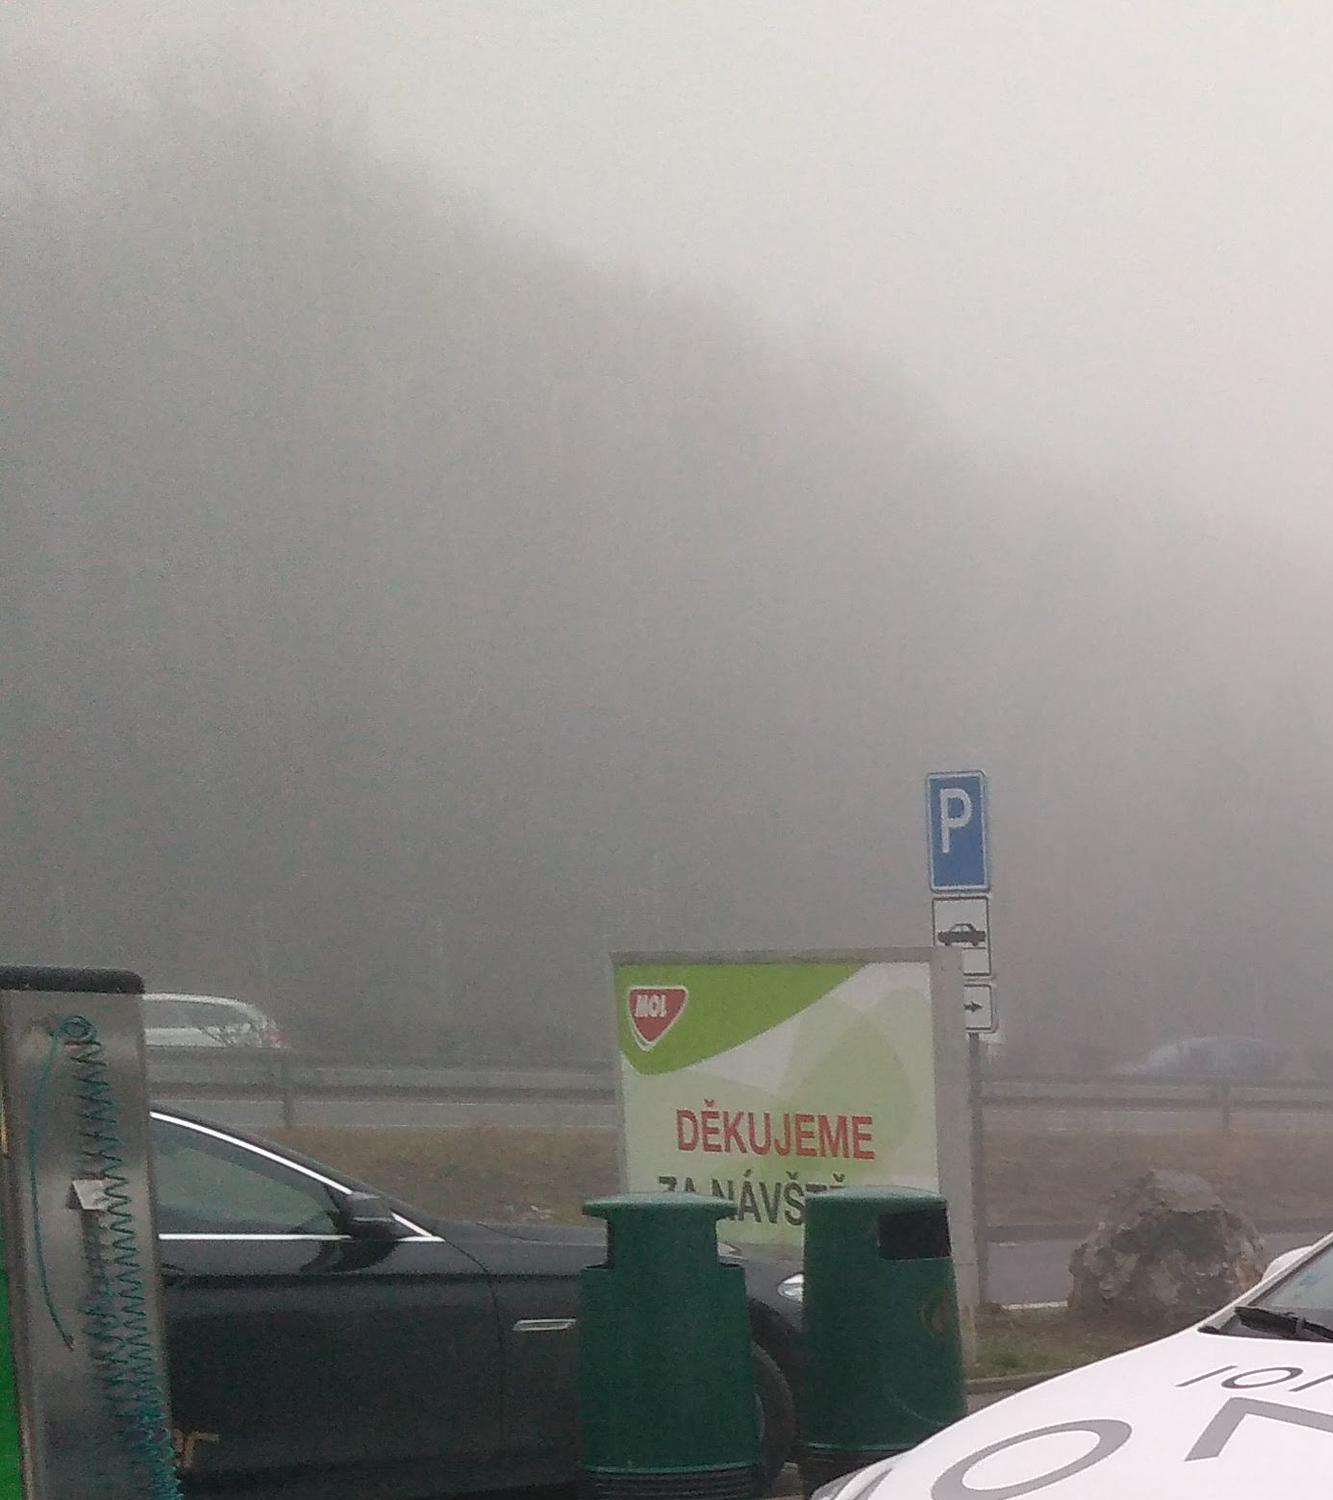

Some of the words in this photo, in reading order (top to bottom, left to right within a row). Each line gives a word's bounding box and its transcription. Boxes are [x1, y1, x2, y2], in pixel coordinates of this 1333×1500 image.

[940, 787, 973, 853] P
[634, 994, 667, 1018] MOL
[676, 1099, 875, 1159] DĚKUJEME
[711, 1168, 847, 1226] NÁVŠ
